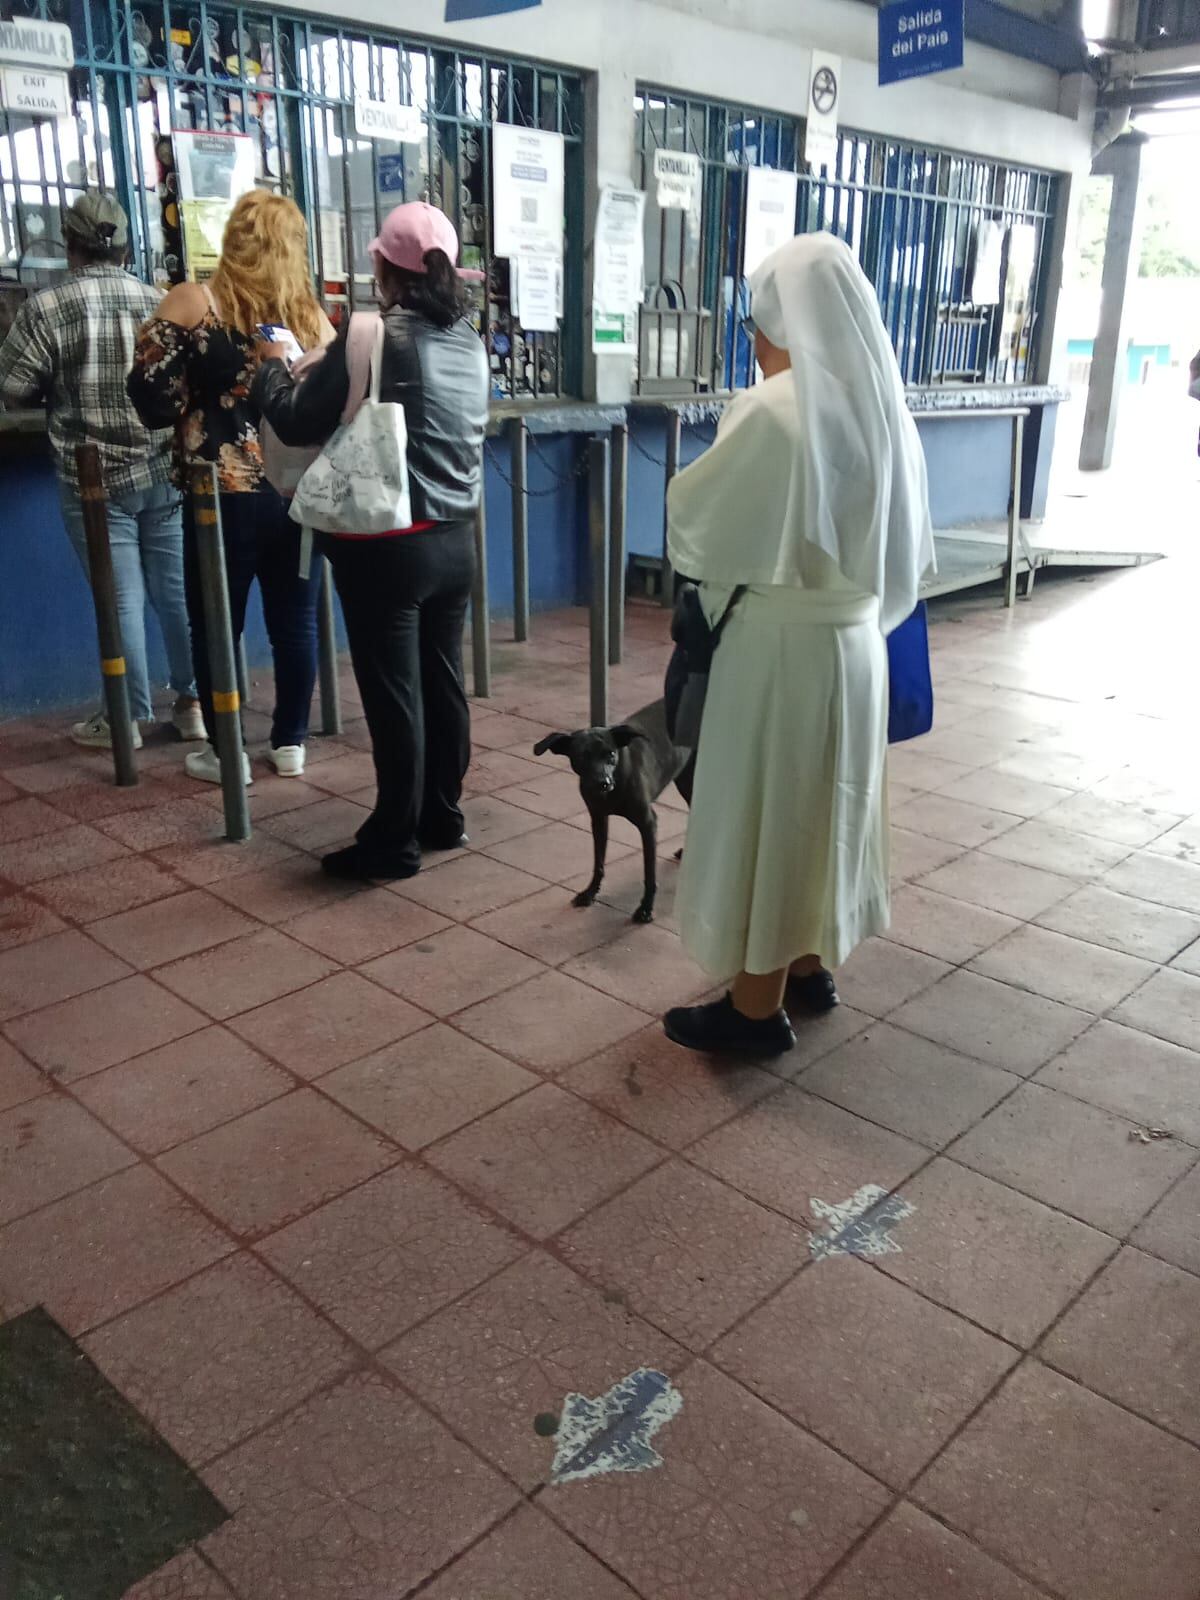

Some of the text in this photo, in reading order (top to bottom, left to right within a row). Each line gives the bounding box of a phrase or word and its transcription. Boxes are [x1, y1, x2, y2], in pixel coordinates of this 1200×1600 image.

[898, 8, 942, 33] Salida
[891, 37, 913, 57] del
[23, 74, 47, 88] EXIT
[16, 93, 57, 109] SALIDA
